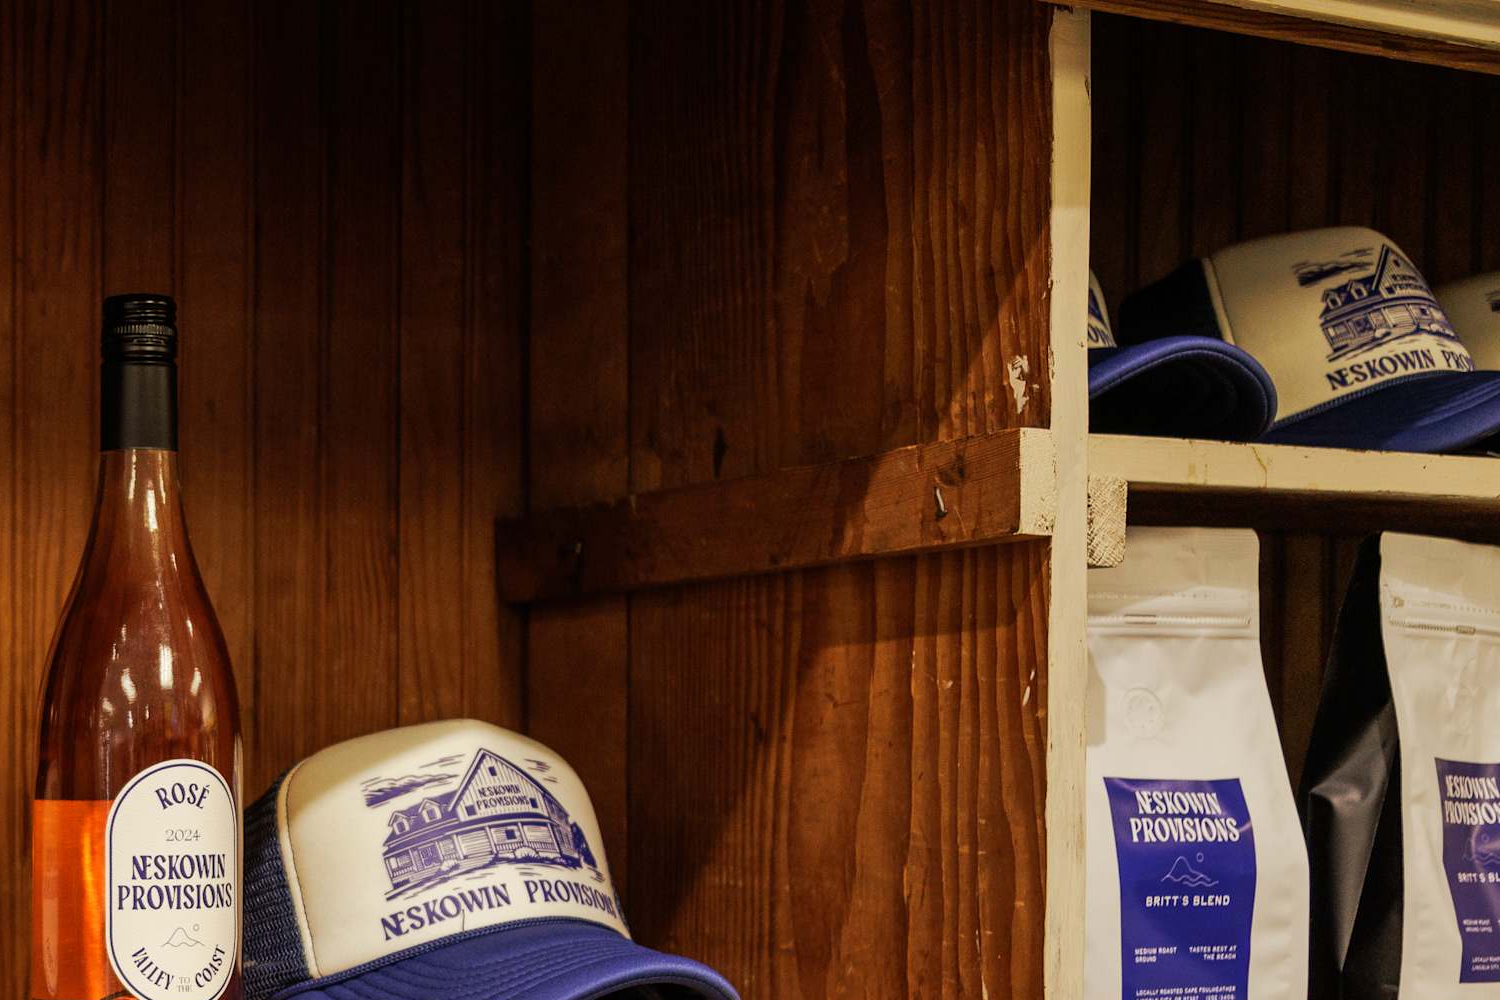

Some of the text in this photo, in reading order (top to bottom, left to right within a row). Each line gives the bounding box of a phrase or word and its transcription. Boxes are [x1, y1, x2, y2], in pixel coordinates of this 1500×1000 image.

[1325, 349, 1436, 390] NESKOWIN
[155, 782, 210, 810] ROSÉ
[478, 784, 521, 797] NESKOWIN
[1445, 775, 1500, 799] NESKOWIN
[1134, 790, 1222, 815] NESKOWIN
[165, 829, 201, 842] 2024
[1129, 817, 1240, 842] PROVISIONS
[131, 853, 225, 880] NESKOWIN
[117, 882, 232, 910] PROVISIONS
[1145, 895, 1230, 908] BRITT'S BLEND
[380, 883, 512, 941] NESKOWIN
[131, 947, 174, 990] VALLEY
[195, 944, 226, 988] COAST
